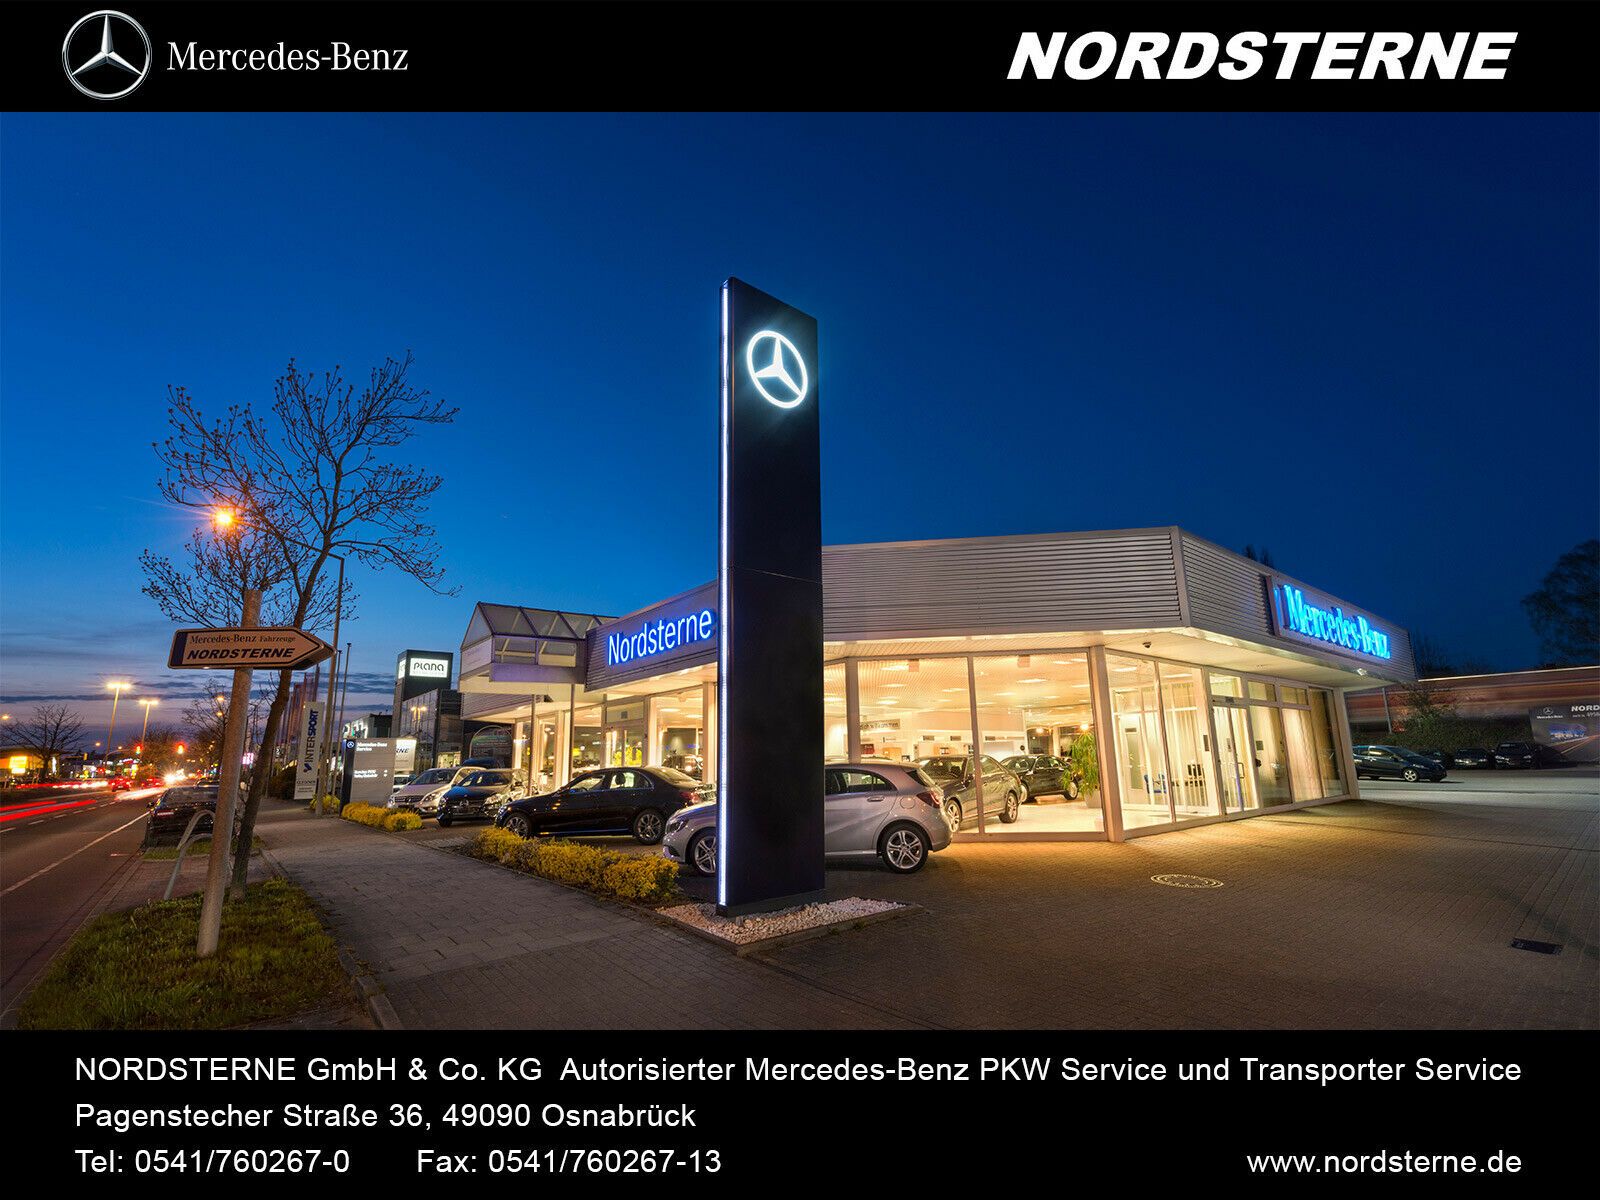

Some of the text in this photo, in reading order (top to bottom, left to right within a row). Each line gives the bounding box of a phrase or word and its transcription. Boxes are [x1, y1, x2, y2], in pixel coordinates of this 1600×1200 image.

[190, 634, 296, 644] Mercedes-Benz Fahrzeuge
[608, 610, 712, 666] Nordsterne
[1283, 584, 1391, 660] Mercedes-Benz
[187, 648, 295, 660] NORDSTERNE
[304, 709, 319, 762] INTERSPORT
